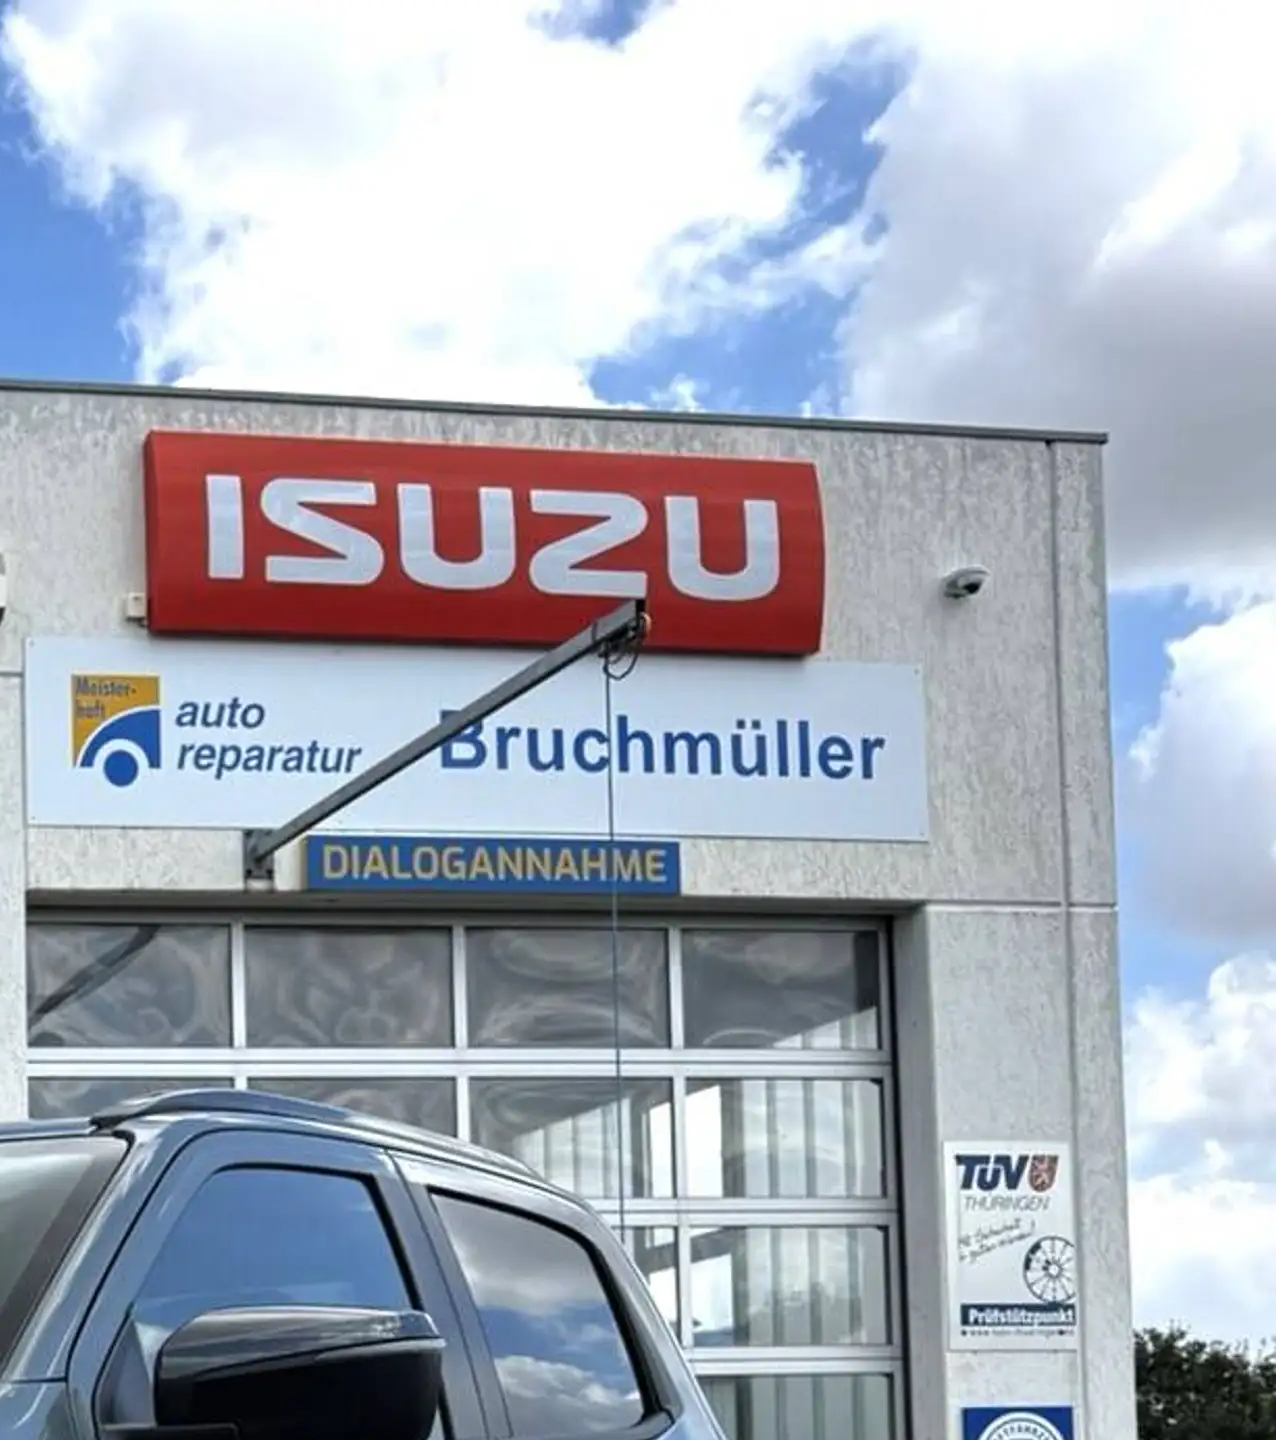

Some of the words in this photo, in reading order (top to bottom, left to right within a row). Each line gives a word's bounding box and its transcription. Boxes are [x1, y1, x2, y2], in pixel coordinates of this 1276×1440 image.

[205, 474, 780, 601] ISUZU
[176, 697, 266, 729] auto
[177, 739, 362, 780] reparatur
[439, 709, 886, 780] Bruchmüller
[323, 842, 667, 884] DIALOGANNAHME
[954, 1154, 1030, 1191] TÜV
